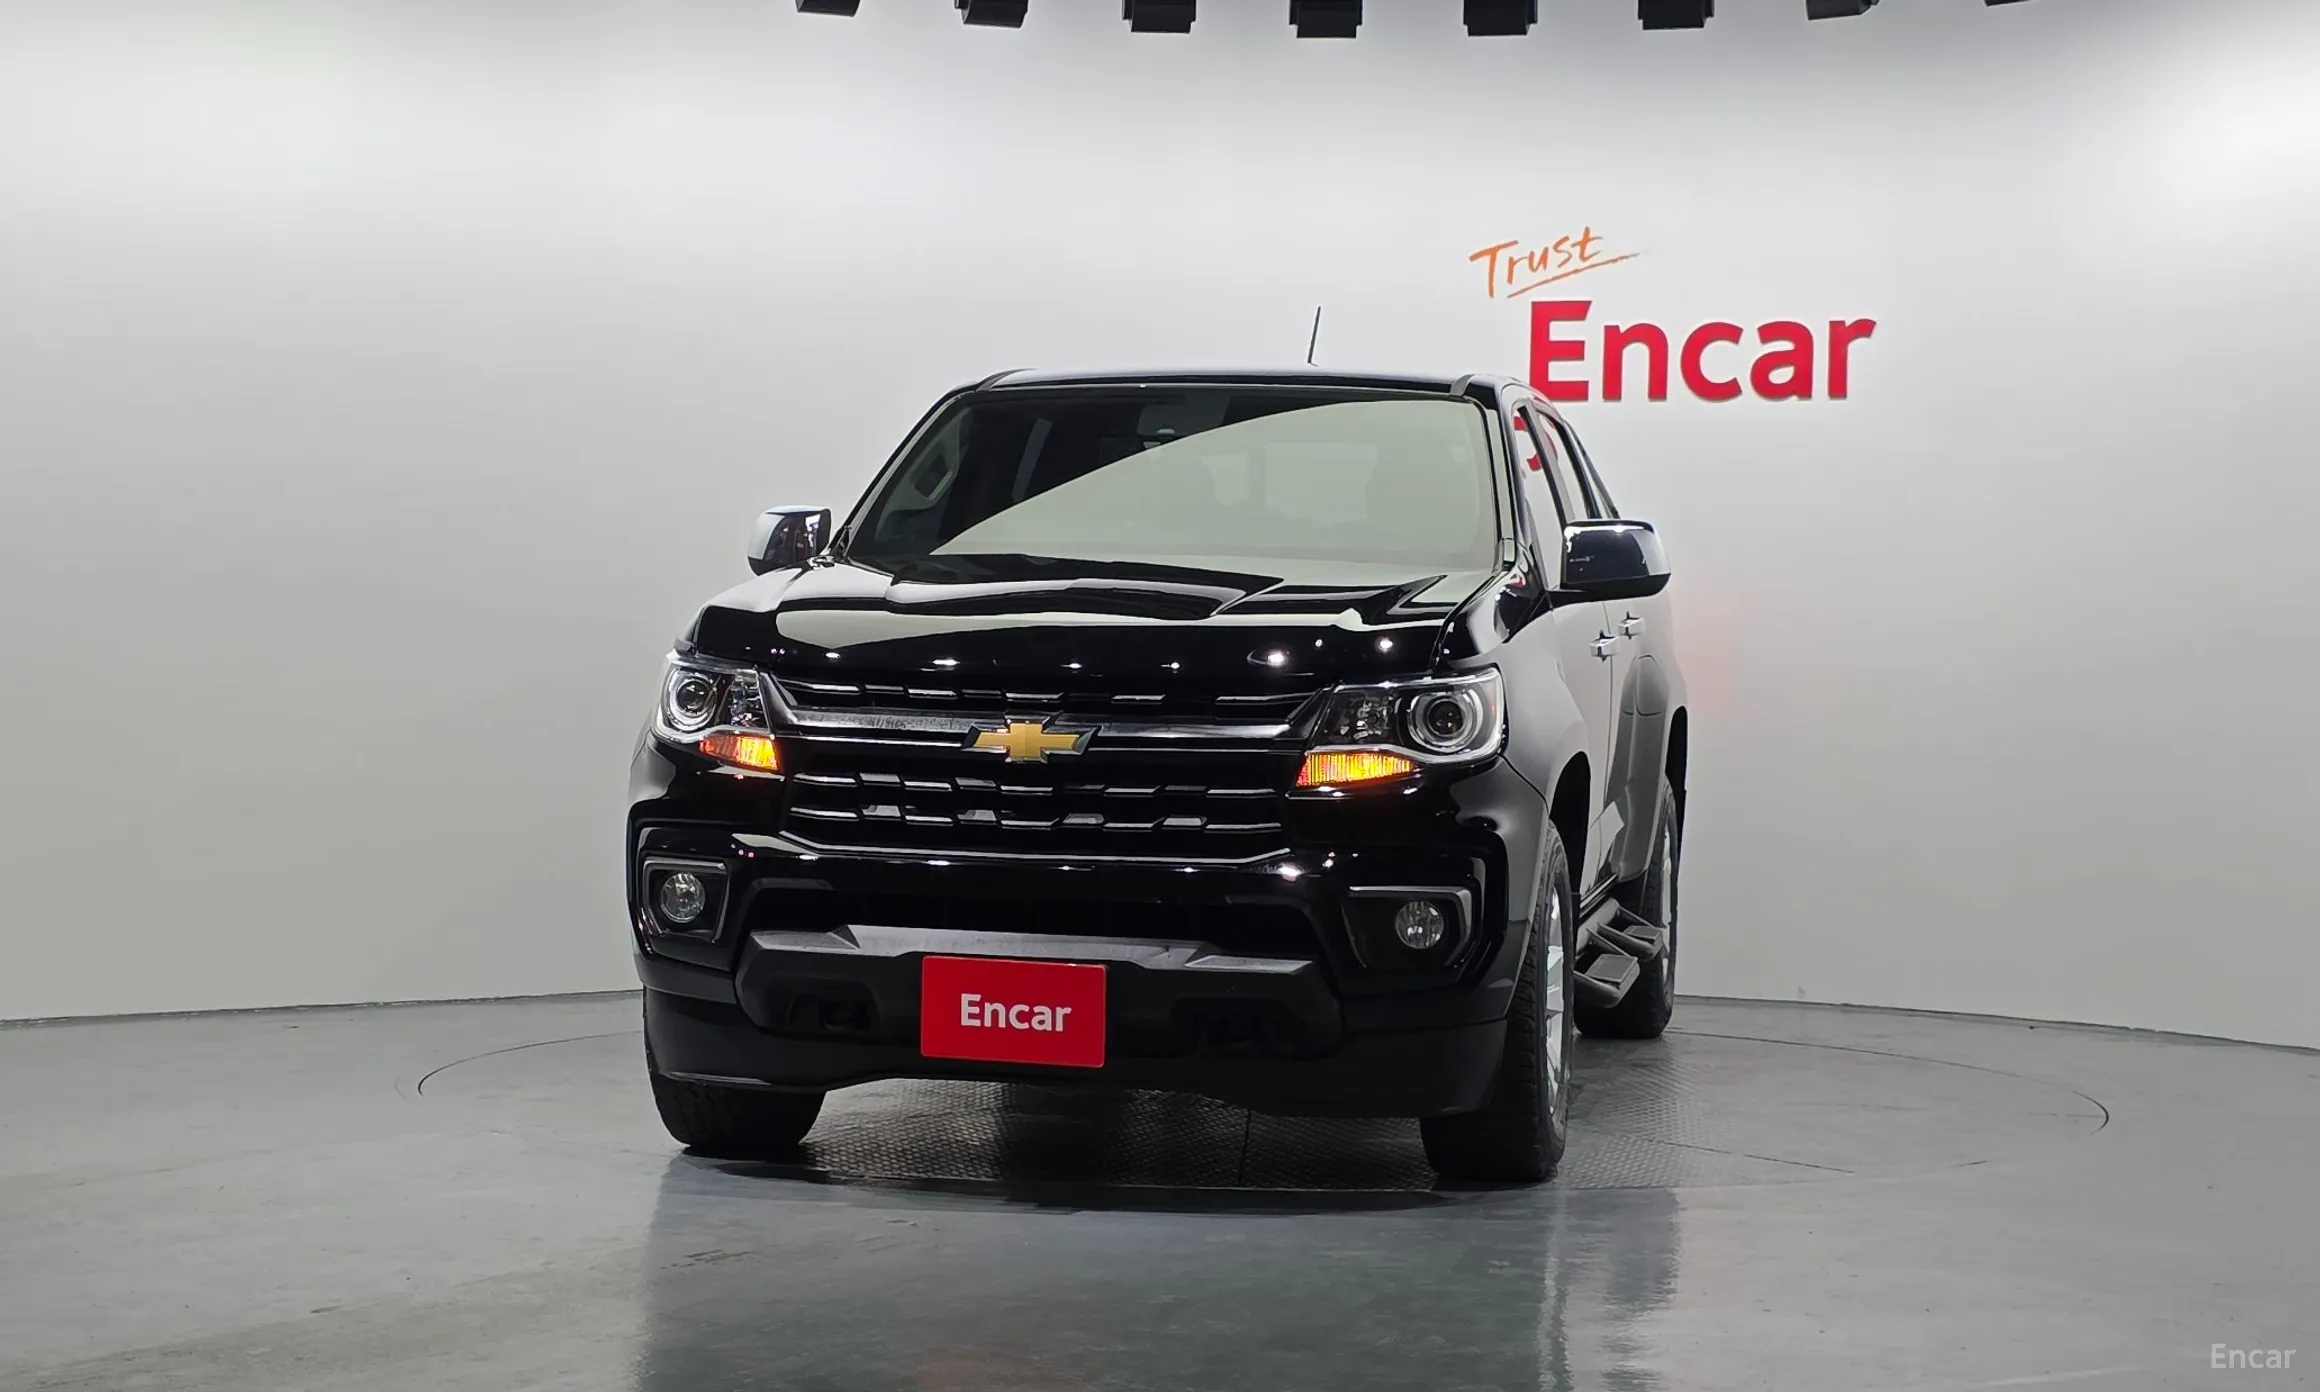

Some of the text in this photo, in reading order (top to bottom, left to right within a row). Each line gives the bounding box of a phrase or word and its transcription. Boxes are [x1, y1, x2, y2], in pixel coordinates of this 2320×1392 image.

[1468, 226, 1604, 299] Trust
[1528, 299, 1877, 403] Encar
[960, 992, 1073, 1033] Encar
